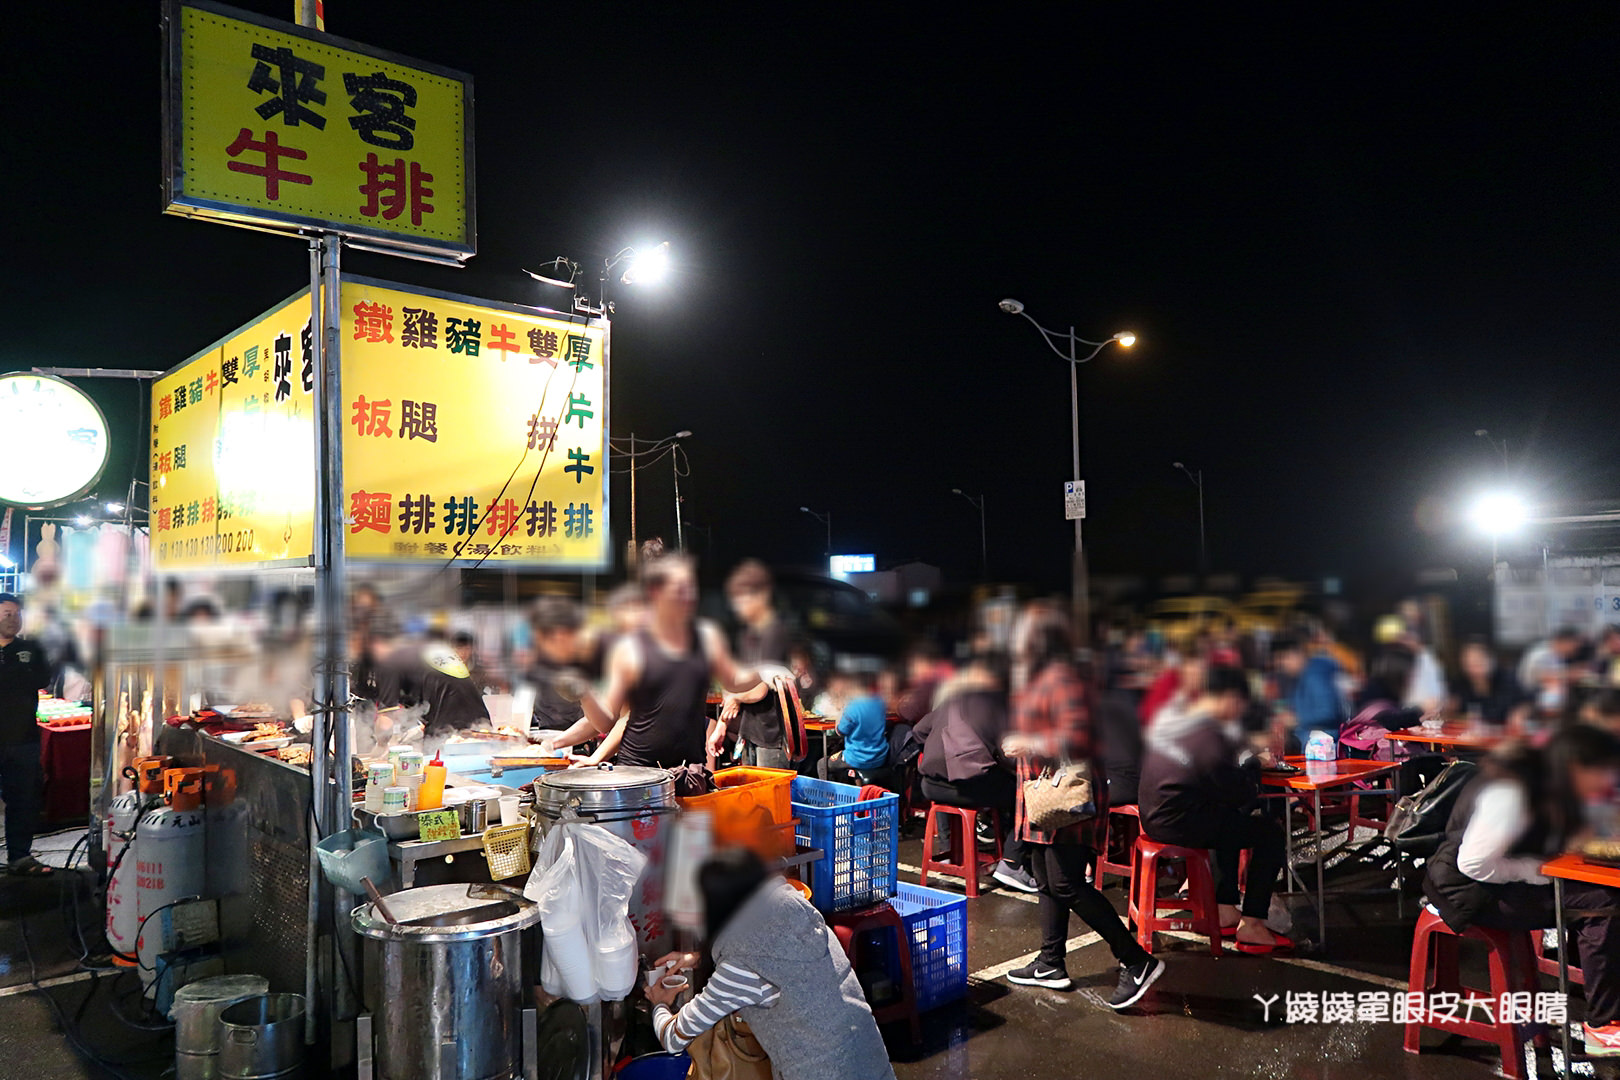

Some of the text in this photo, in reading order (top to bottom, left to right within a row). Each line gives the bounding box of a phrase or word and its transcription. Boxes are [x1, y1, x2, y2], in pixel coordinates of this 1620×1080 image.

[247, 43, 417, 150] 來客
[225, 128, 434, 226] 牛排
[351, 301, 394, 534] 鐵板麵
[398, 306, 438, 534] 雞腿排
[564, 334, 593, 539] 厚片牛排
[215, 532, 233, 553] 200
[236, 529, 254, 552] 200
